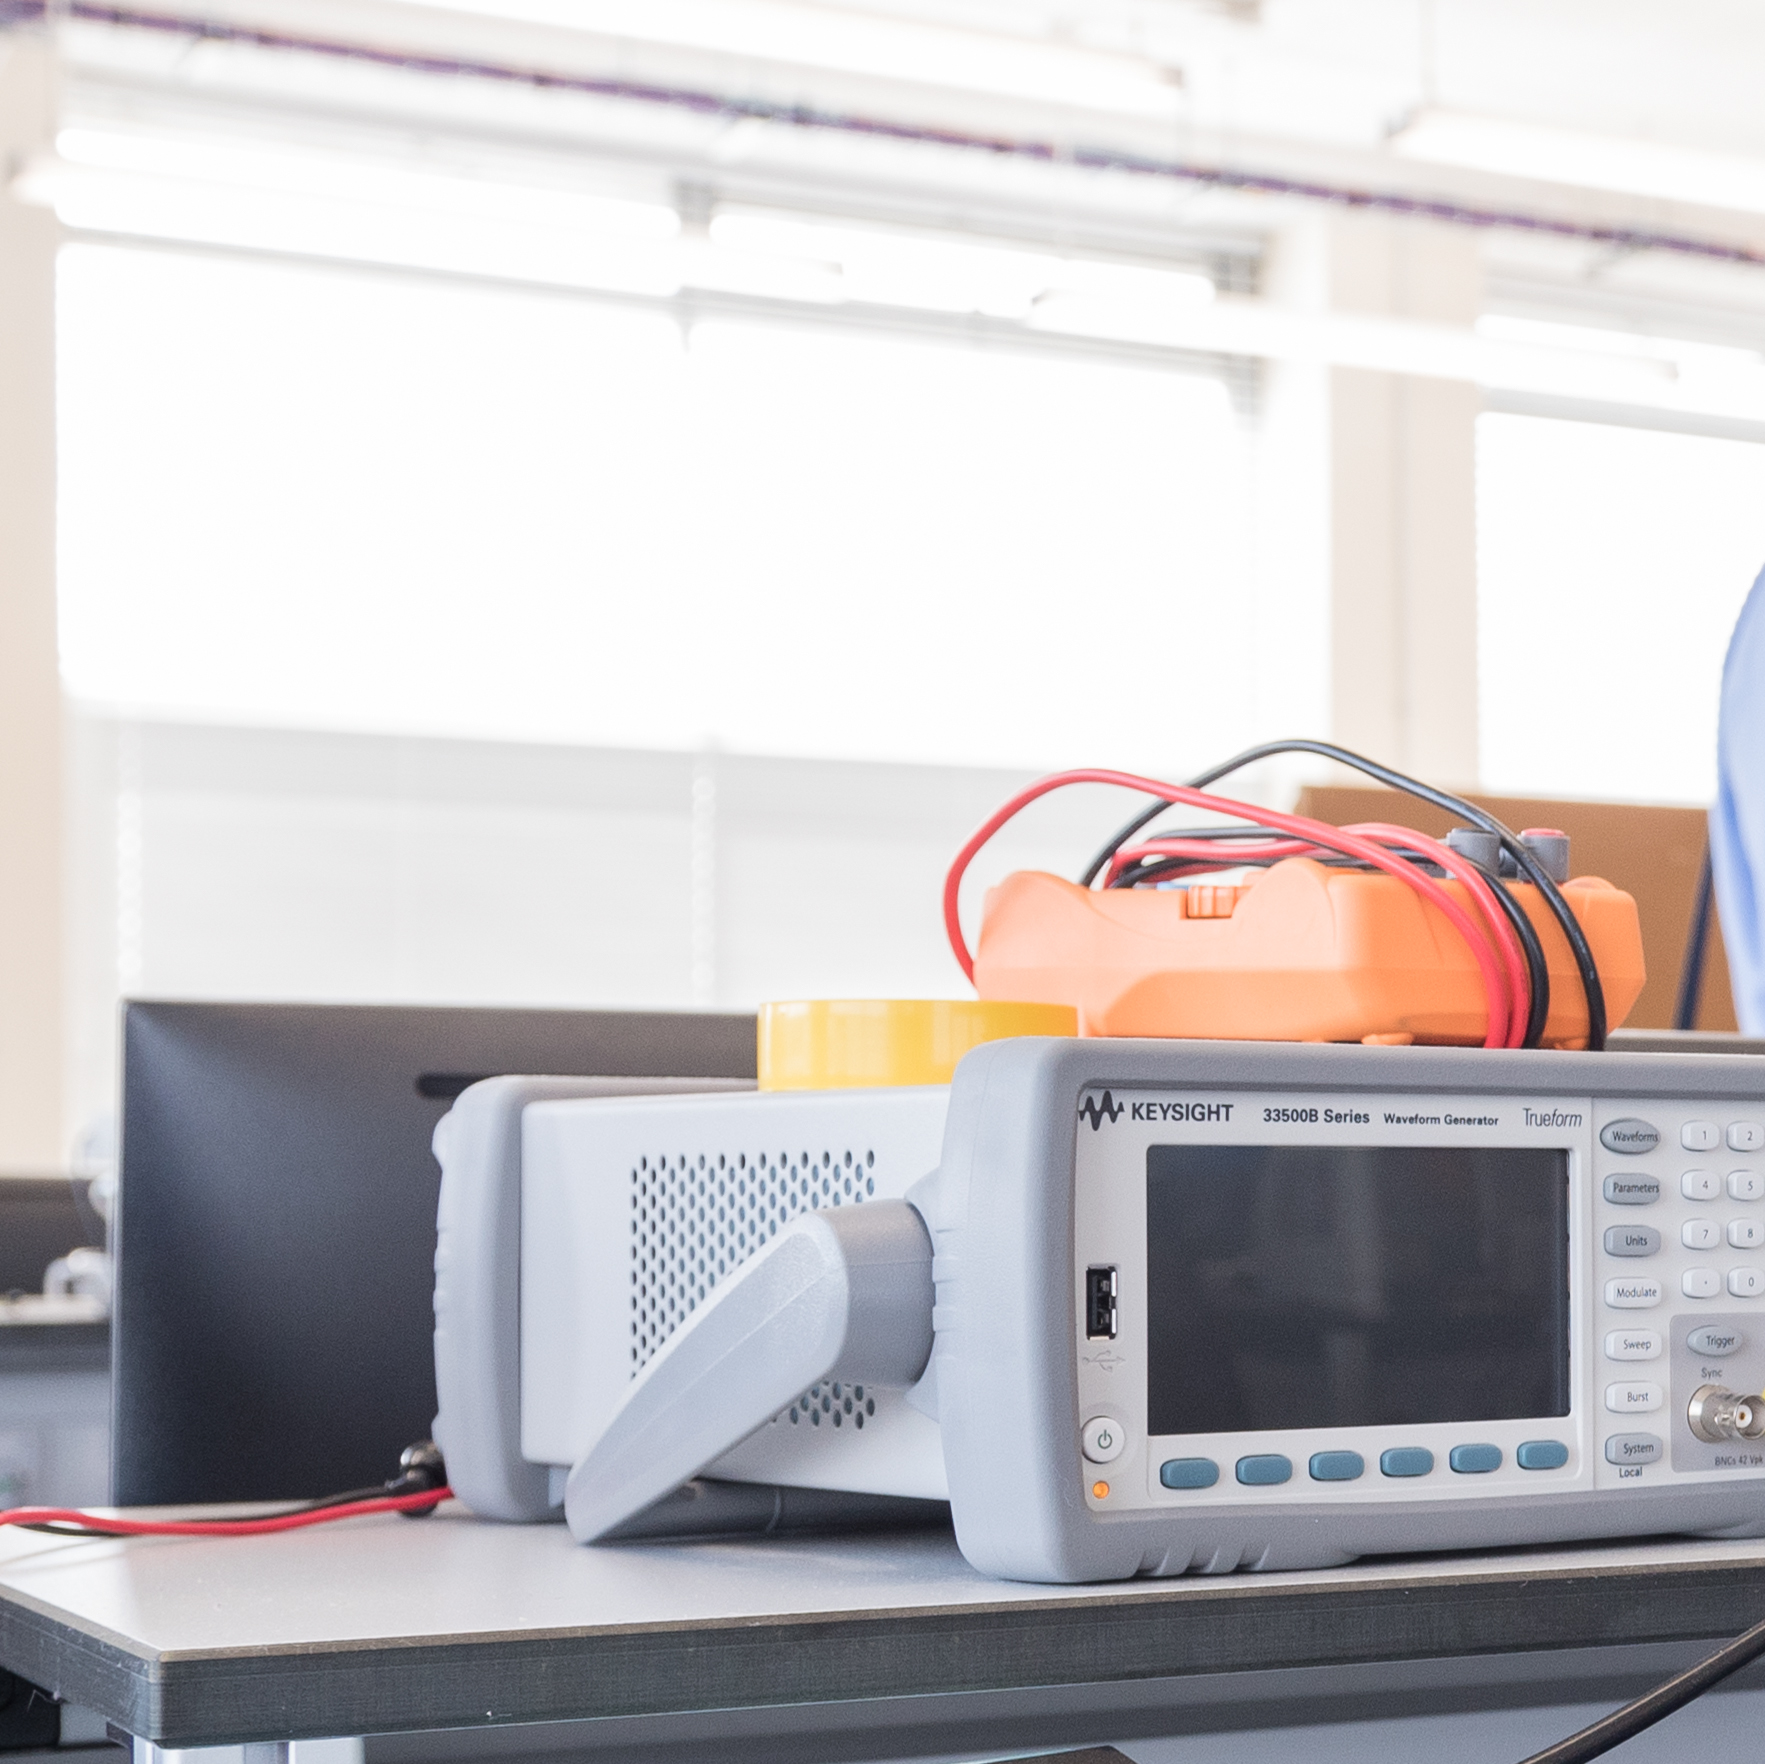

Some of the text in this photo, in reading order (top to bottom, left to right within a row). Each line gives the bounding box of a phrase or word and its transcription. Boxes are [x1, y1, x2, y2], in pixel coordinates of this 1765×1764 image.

[1131, 1102, 1582, 1128] KEYSIGHT 33500B Series Waveform Generator Trueform
[1612, 1131, 1659, 1142] Waveforms
[1747, 1131, 1753, 1141] 2
[1613, 1182, 1660, 1194] Parameters
[1702, 1180, 1709, 1190] 4
[1748, 1181, 1753, 1191] 5
[1703, 1229, 1709, 1240] 7
[1747, 1228, 1753, 1239] 8
[1625, 1235, 1648, 1247] Units
[1748, 1277, 1755, 1287] 0
[1616, 1287, 1657, 1298] Modulate
[1623, 1339, 1652, 1351] Sweep
[1706, 1334, 1735, 1348] Trigger
[1701, 1368, 1722, 1380] Sync
[1627, 1391, 1649, 1403] Burst
[1623, 1443, 1654, 1456] System
[1619, 1466, 1643, 1479] Local
